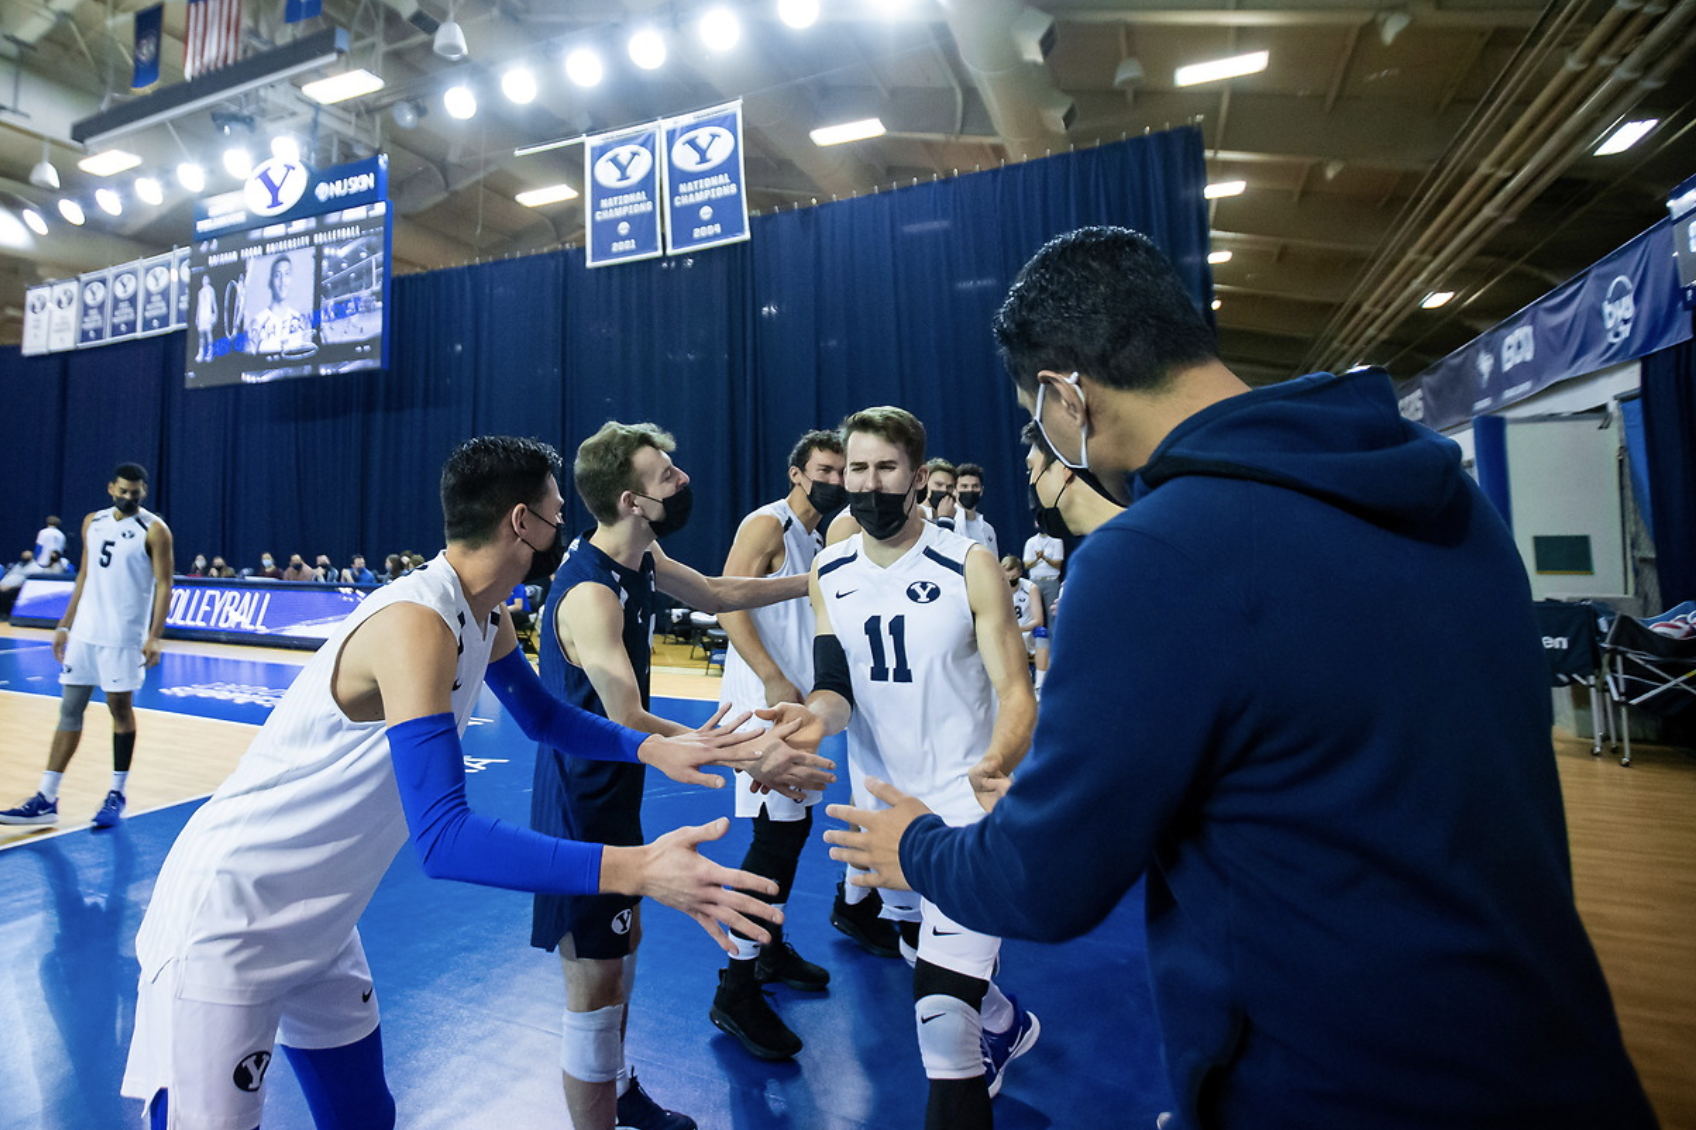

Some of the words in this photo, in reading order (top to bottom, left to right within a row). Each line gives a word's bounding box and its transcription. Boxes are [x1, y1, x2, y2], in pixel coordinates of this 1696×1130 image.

[679, 173, 731, 193] NATIONAL
[600, 191, 648, 209] NATIONAL
[673, 183, 737, 207] CHAMPIONS
[595, 201, 653, 221] CHAMPIONS
[693, 223, 722, 239] 2004
[99, 540, 115, 568] 5
[910, 582, 936, 603] Y
[864, 614, 913, 682] 11
[242, 1053, 270, 1089] Y
